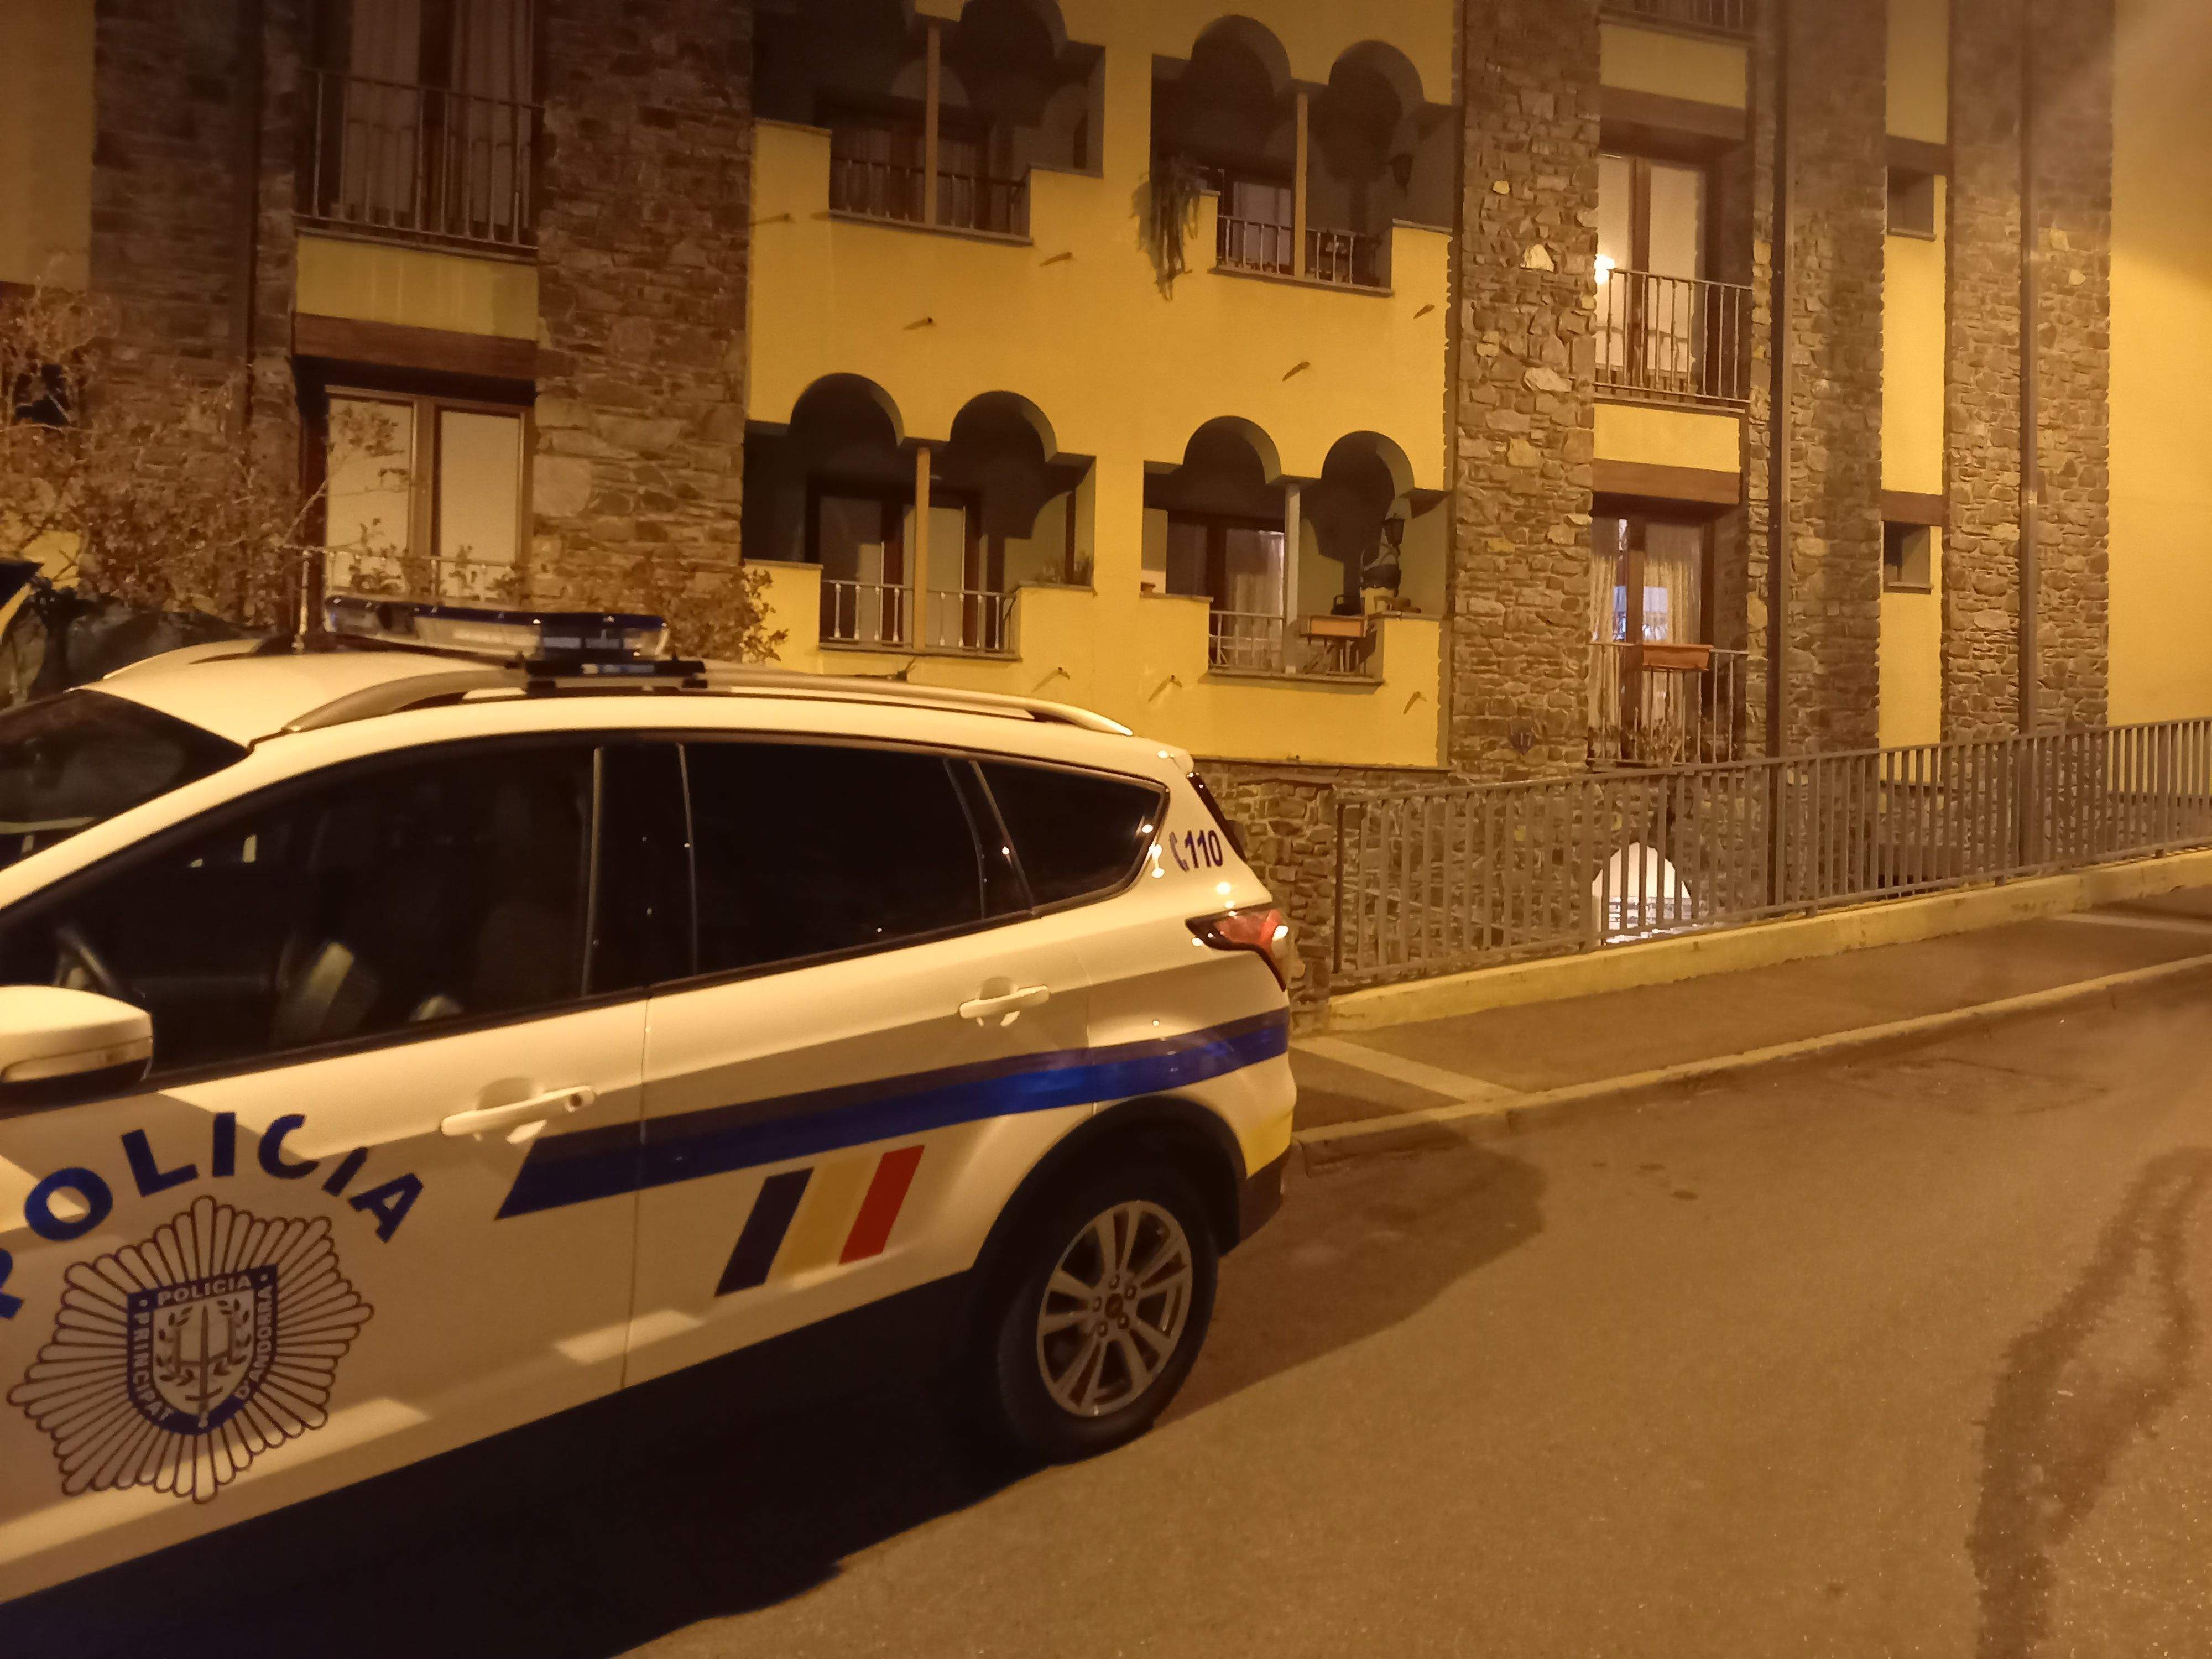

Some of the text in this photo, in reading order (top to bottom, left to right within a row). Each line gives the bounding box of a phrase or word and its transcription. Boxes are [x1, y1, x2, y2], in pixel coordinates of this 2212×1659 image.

[1185, 830, 1223, 868] 110
[158, 1276, 251, 1306] POLICIA
[133, 1313, 174, 1422] PRINCIPAT
